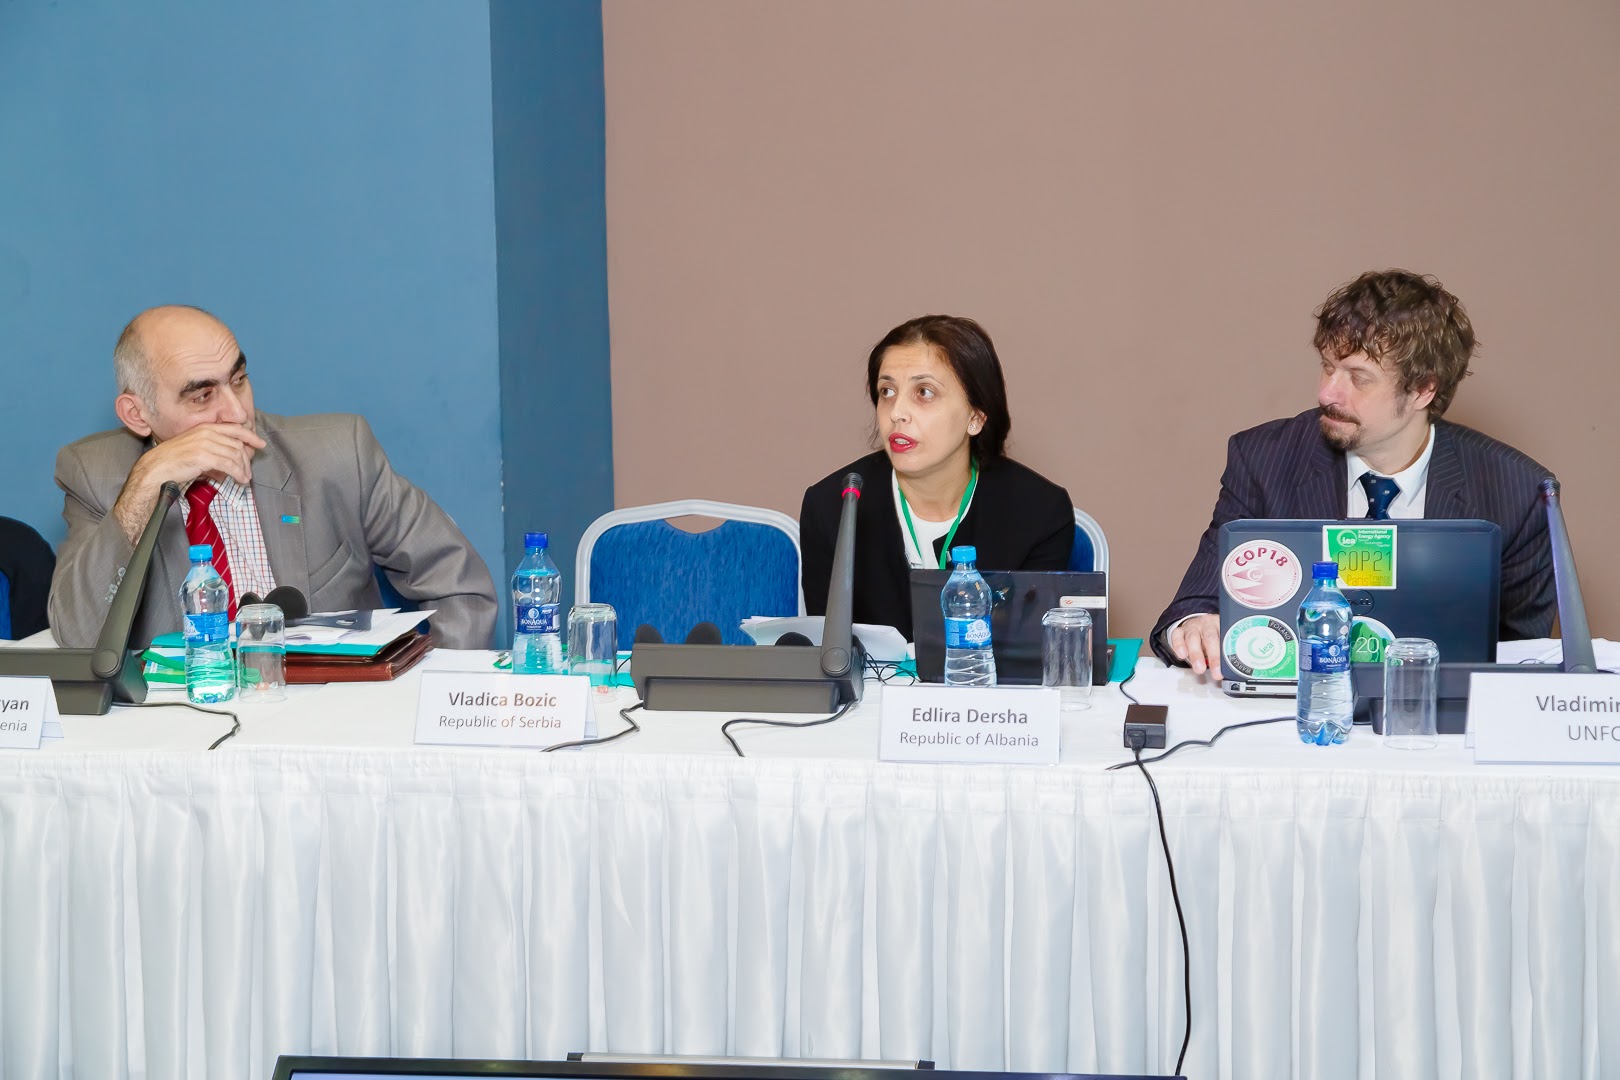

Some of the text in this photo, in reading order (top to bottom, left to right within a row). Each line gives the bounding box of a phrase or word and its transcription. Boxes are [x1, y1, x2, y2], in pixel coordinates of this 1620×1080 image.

[1235, 547, 1288, 567] COP18
[1337, 550, 1392, 572] COP21
[1269, 621, 1292, 640] POLAND
[448, 691, 557, 707] Vladica Bozic
[439, 715, 561, 730] Republic of Serbia
[912, 707, 1028, 724] Edlira Dersha
[900, 731, 1039, 747] Republic of Albania
